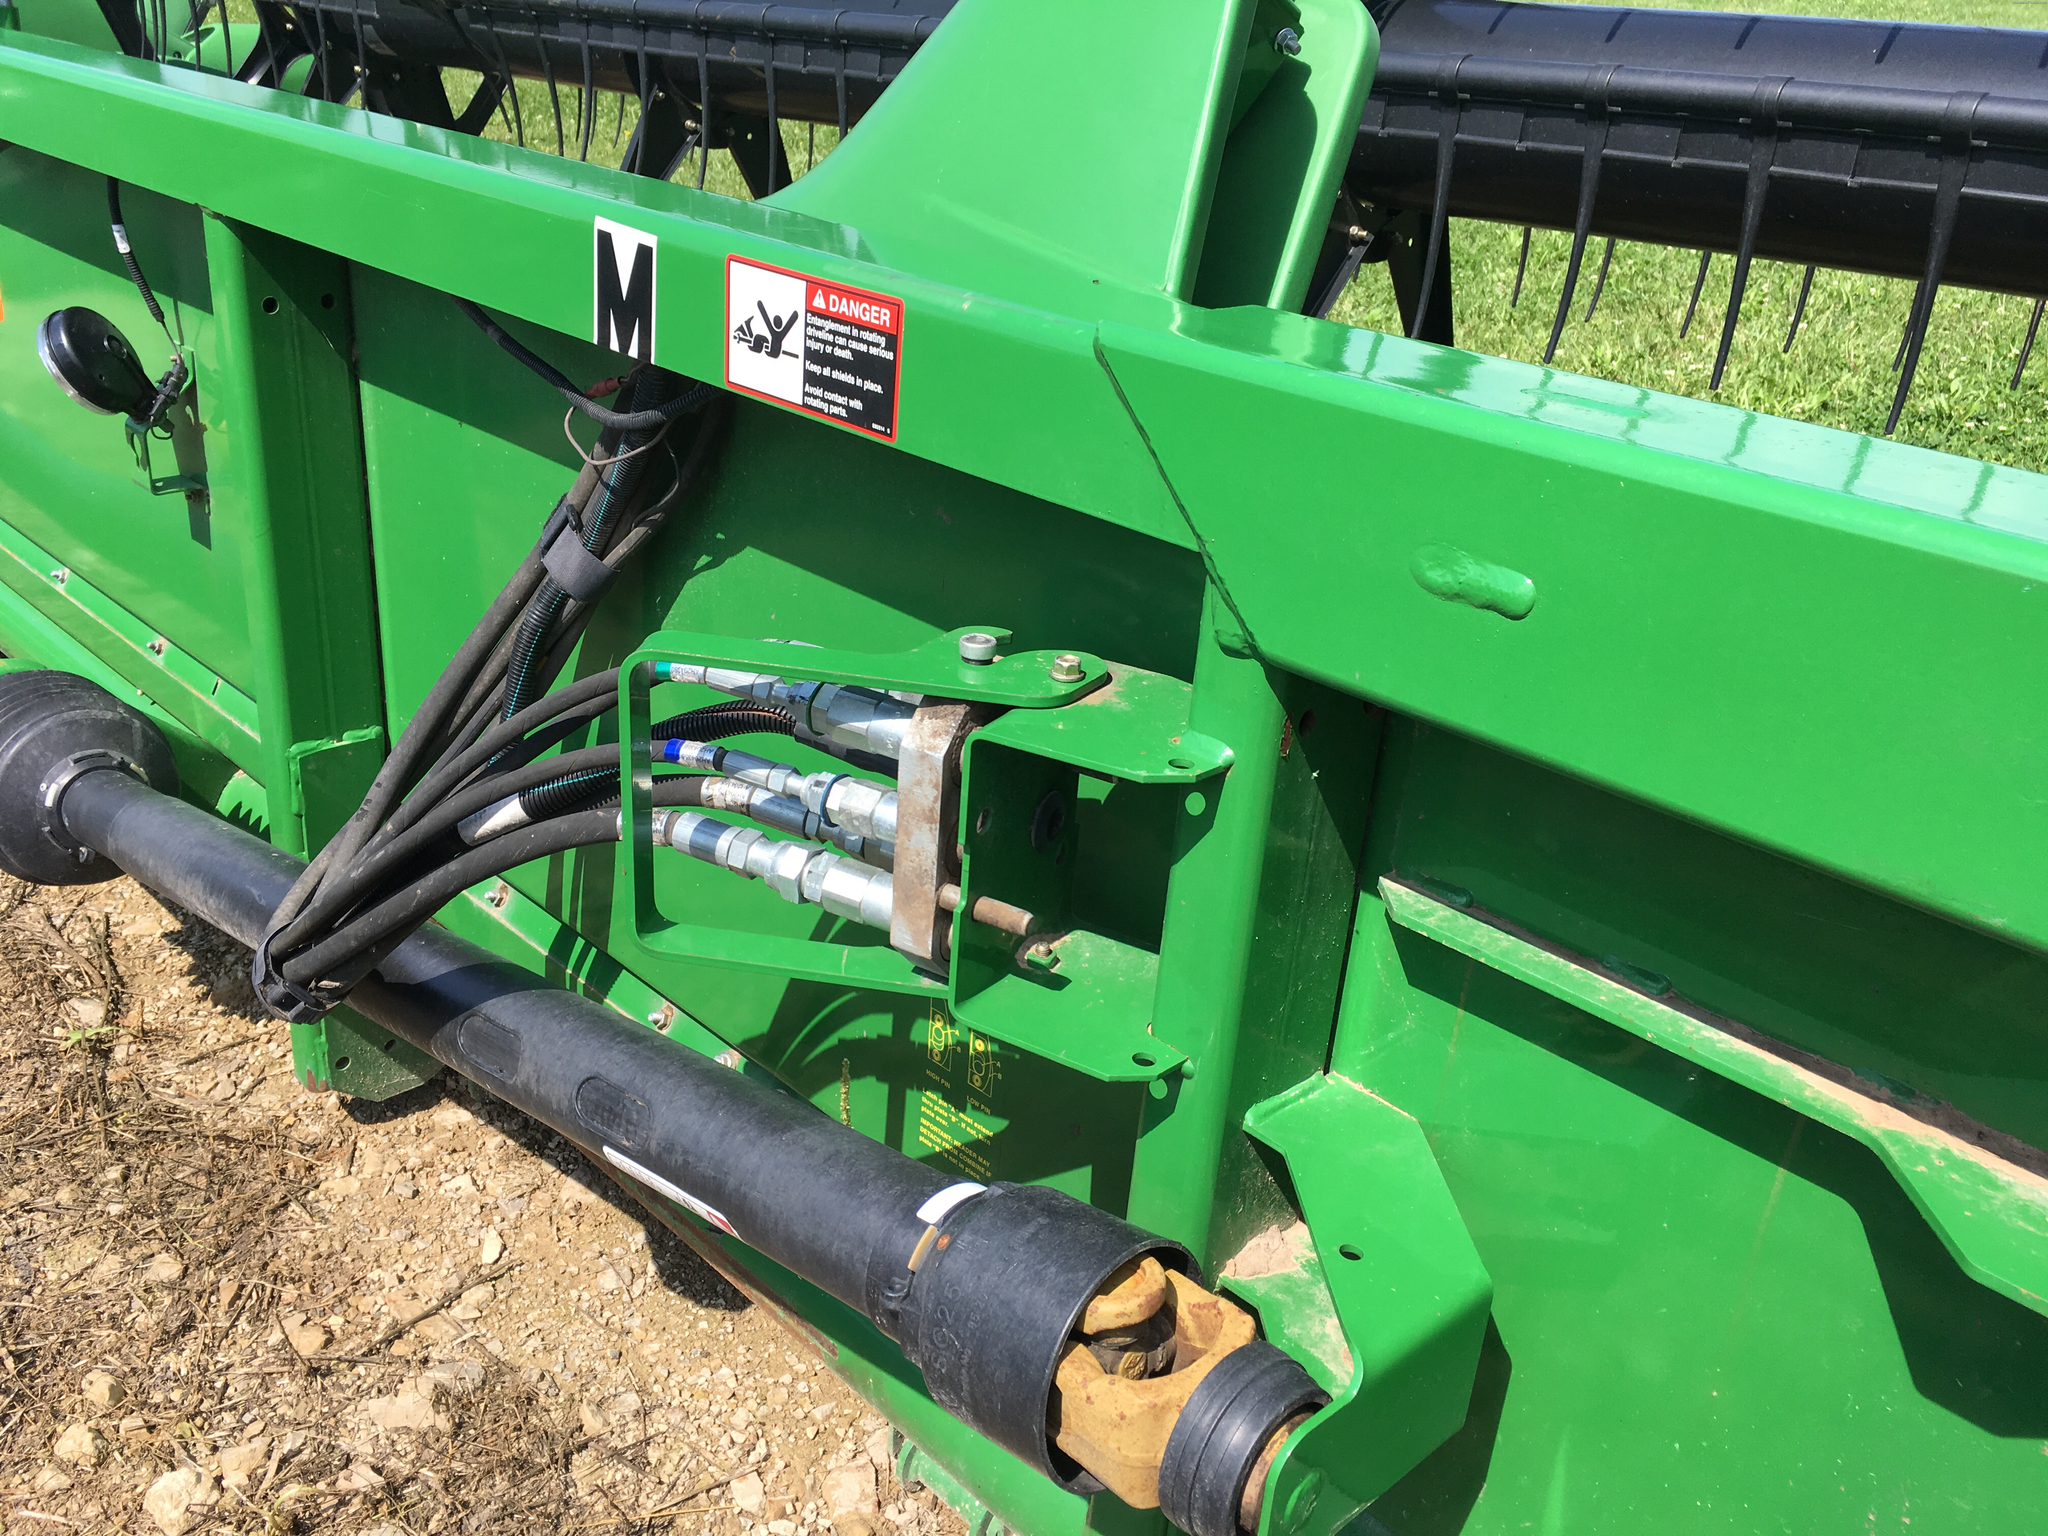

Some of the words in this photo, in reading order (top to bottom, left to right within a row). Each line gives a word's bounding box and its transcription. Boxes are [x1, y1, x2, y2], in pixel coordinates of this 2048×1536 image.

[597, 228, 653, 364] M
[829, 294, 891, 327] DANGER
[806, 313, 851, 335] Entanglement
[852, 326, 859, 337] in
[860, 331, 886, 347] rotating
[806, 325, 834, 342] driveline
[835, 335, 847, 346] can
[848, 339, 868, 352] cause
[869, 345, 894, 361] serious
[805, 337, 824, 353] injury
[825, 344, 833, 354] or
[833, 346, 854, 361] death.
[805, 360, 822, 376] Keep
[822, 366, 831, 377] all
[831, 369, 855, 385] shields
[856, 376, 863, 387] in
[863, 379, 884, 394] place.
[804, 382, 823, 397] Avoid
[824, 390, 848, 406] contact
[849, 398, 863, 411] with
[804, 396, 829, 413] rotating
[829, 402, 848, 418] parts.
[926, 1069, 940, 1082] HIGH
[941, 1079, 951, 1089] PIN
[921, 1106, 935, 1118] plate
[935, 1116, 949, 1127] over.
[921, 1096, 933, 1107] thru
[934, 1105, 948, 1117] plate
[966, 1127, 977, 1138] not,
[922, 1087, 938, 1101] Latch
[938, 1098, 948, 1108] pin
[959, 1112, 973, 1124] must
[974, 1122, 994, 1137] extend
[967, 1095, 980, 1107] LOW
[981, 1104, 991, 1115] PIN
[919, 1125, 941, 1144] DETACH
[942, 1141, 958, 1155] FROM
[959, 1153, 985, 1174] COMBINE
[919, 1135, 932, 1148] plate
[942, 1150, 948, 1158] is
[948, 1156, 958, 1165] not
[958, 1161, 964, 1170] in
[965, 1166, 981, 1181] place.
[920, 1117, 953, 1143] IMPORTANT:
[953, 1139, 977, 1158] HEADER
[978, 1156, 991, 1168] MAY
